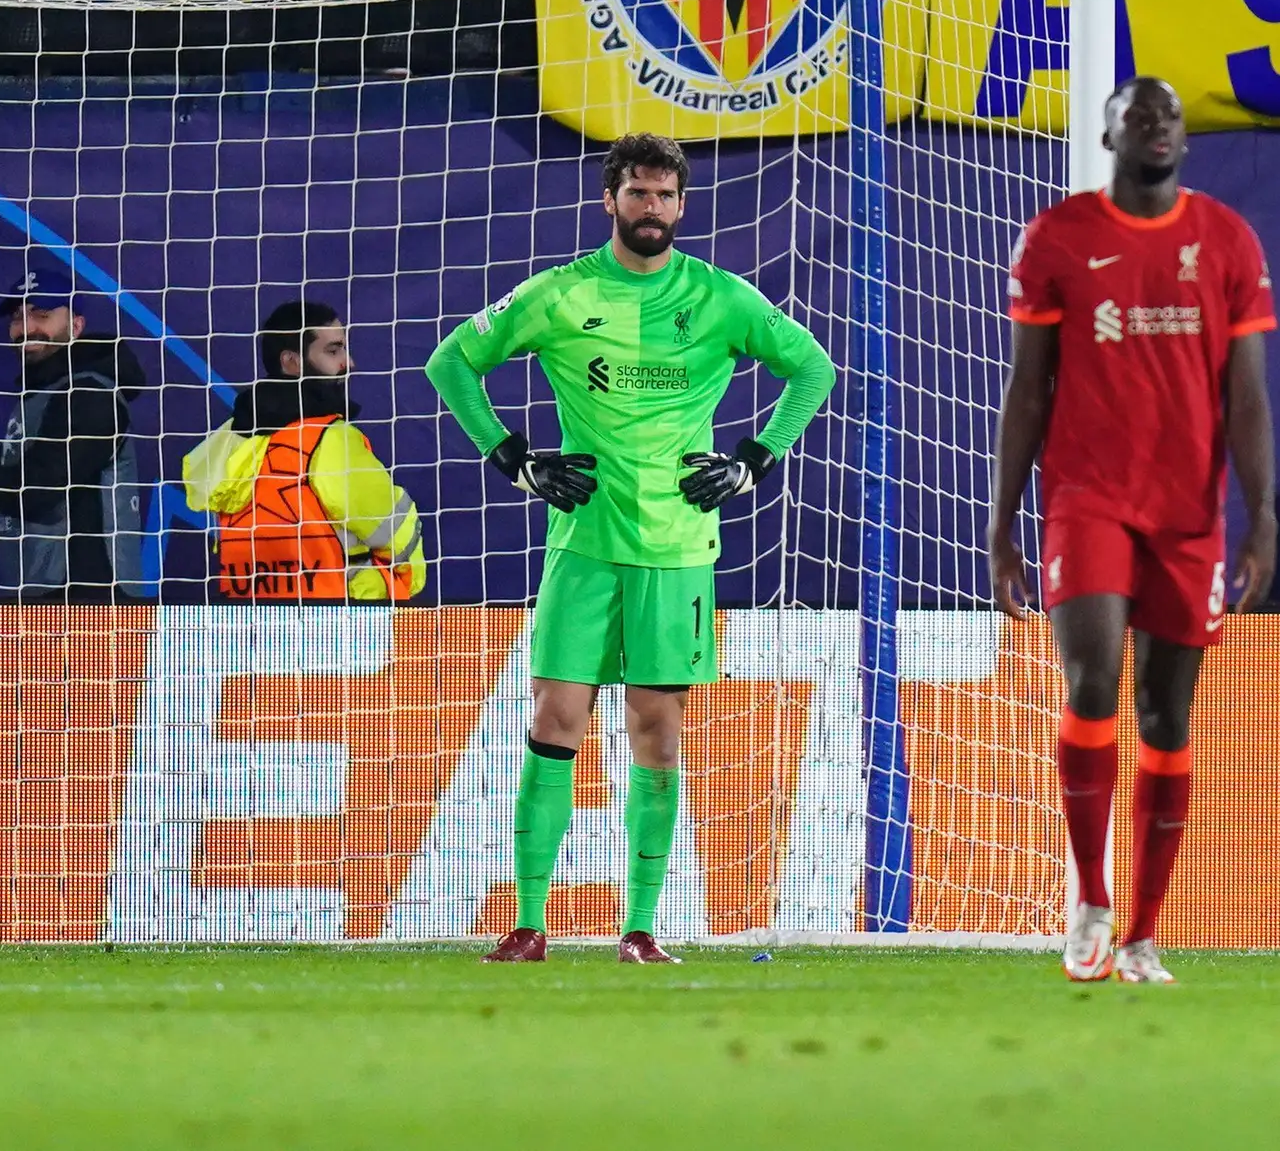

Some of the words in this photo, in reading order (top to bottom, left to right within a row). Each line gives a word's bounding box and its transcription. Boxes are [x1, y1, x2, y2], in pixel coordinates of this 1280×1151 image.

[615, 364, 688, 378] standard
[615, 377, 691, 391] chartered
[691, 595, 701, 639] 1
[109, 604, 1005, 944] EAT
